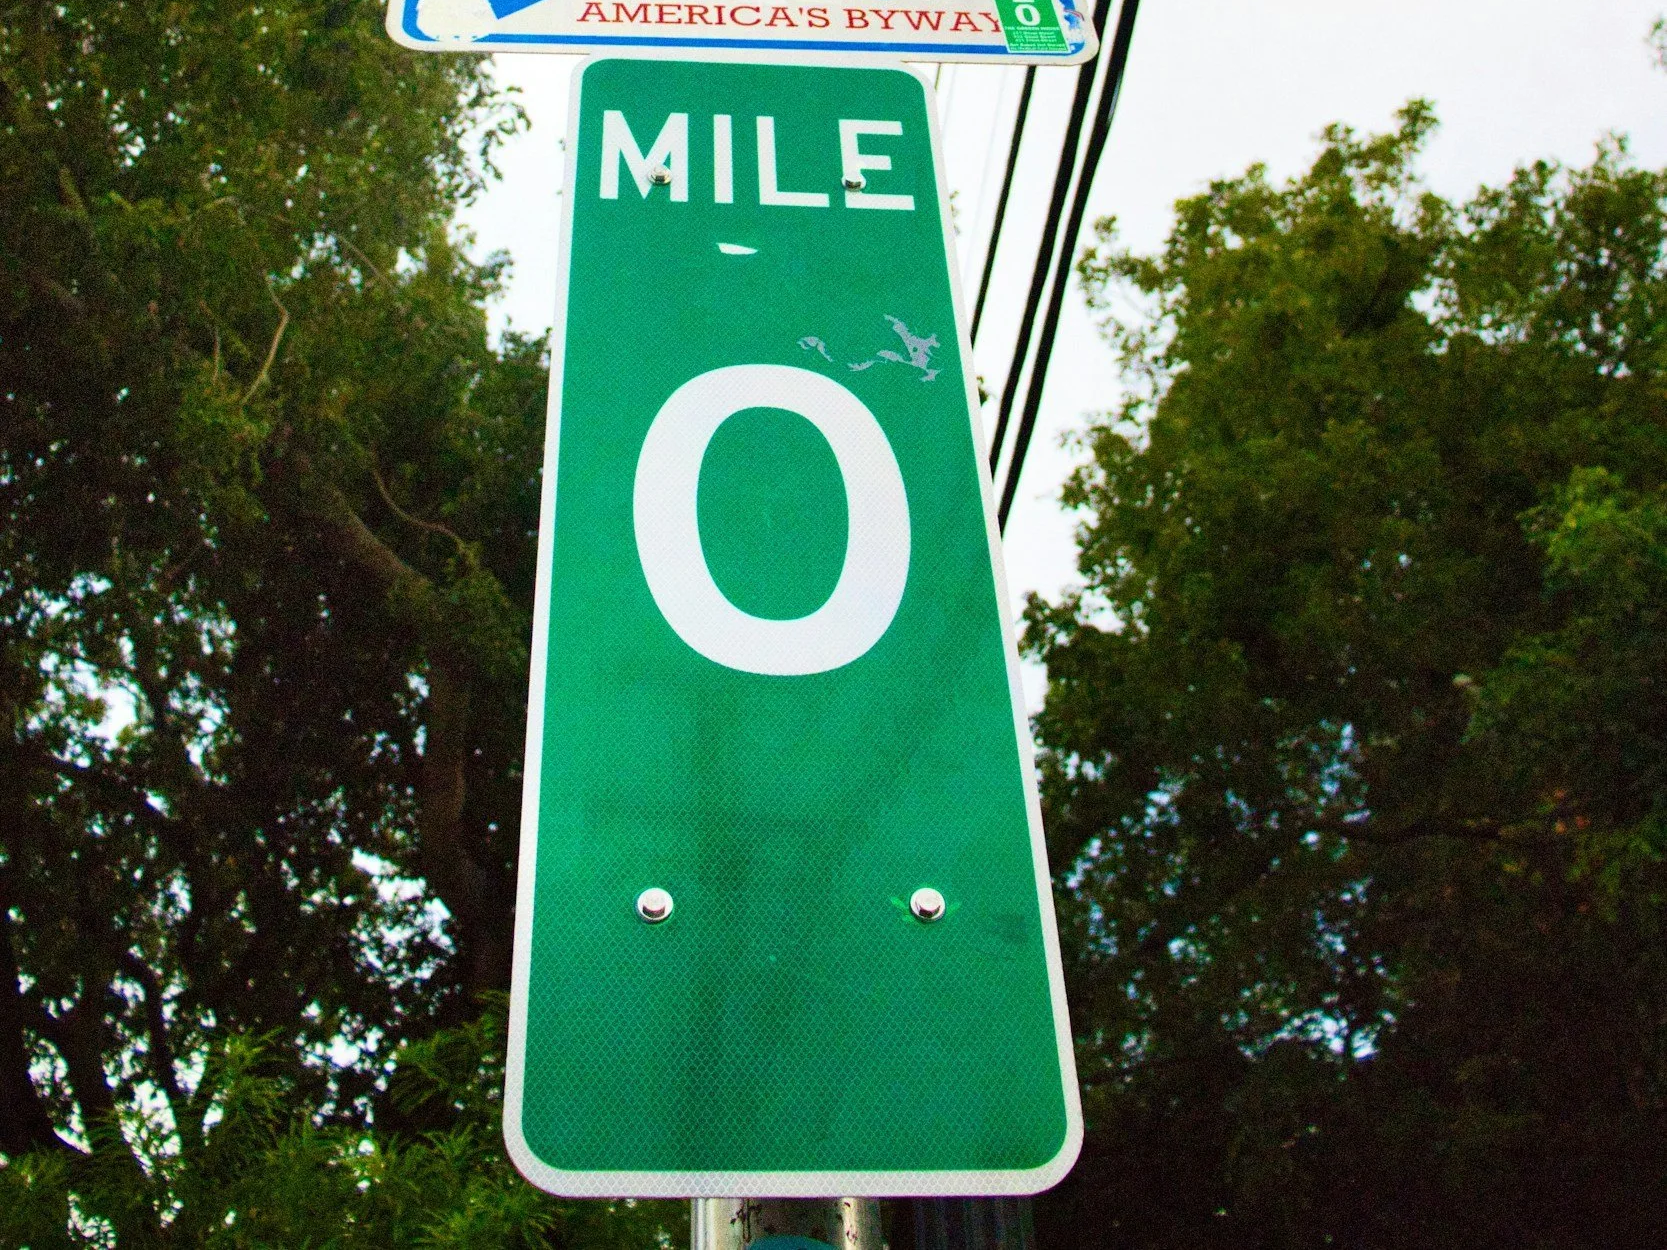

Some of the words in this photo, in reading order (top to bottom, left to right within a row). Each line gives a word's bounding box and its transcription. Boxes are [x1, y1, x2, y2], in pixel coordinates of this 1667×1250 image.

[576, 2, 831, 29] AMERICA'S
[843, 8, 1002, 32] BYWAY
[600, 110, 915, 210] MILE
[633, 363, 911, 676] 0
